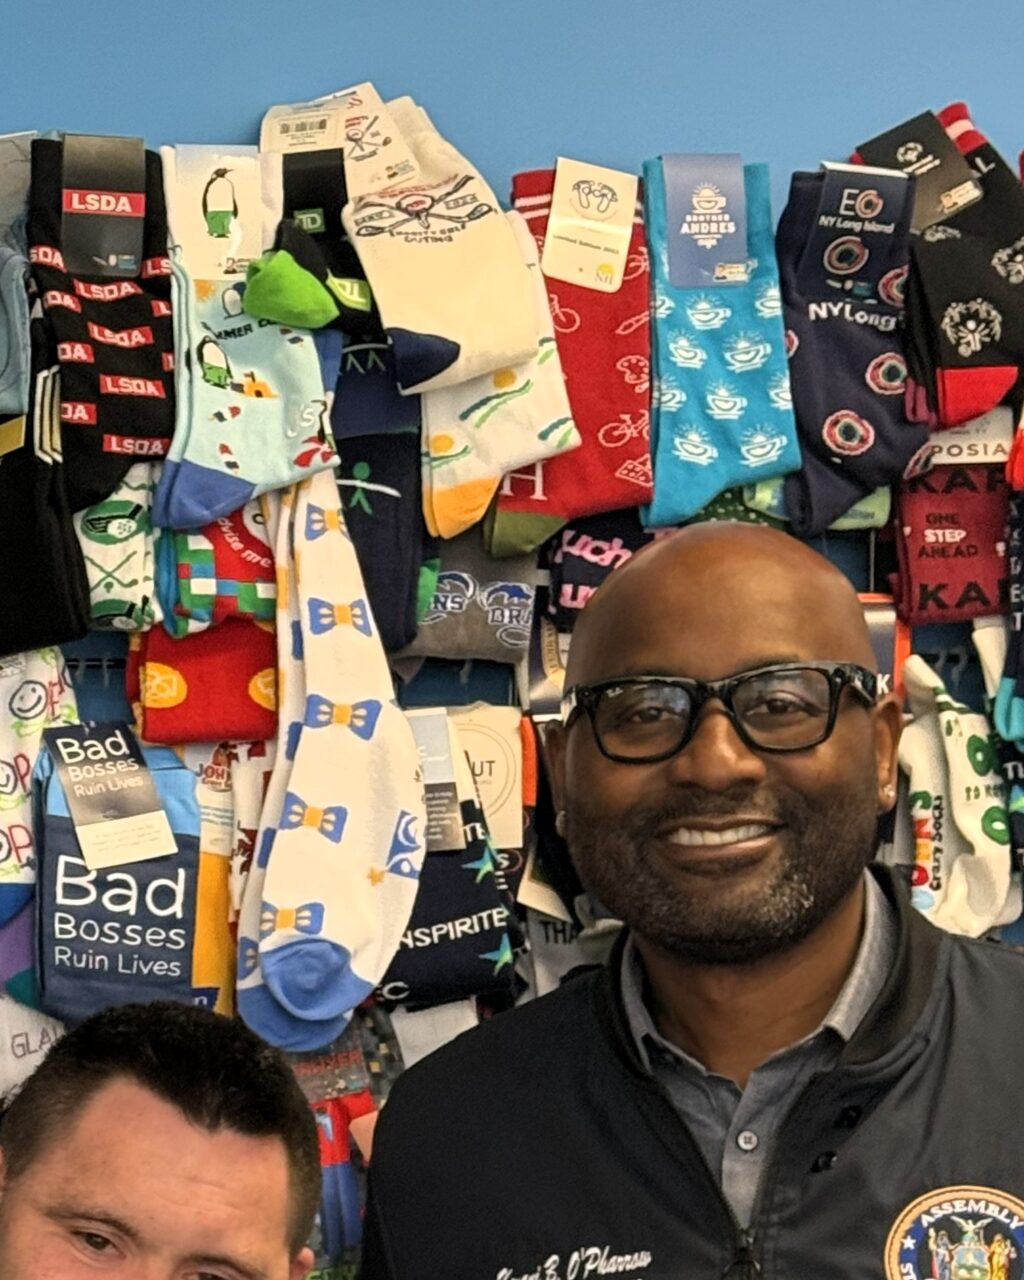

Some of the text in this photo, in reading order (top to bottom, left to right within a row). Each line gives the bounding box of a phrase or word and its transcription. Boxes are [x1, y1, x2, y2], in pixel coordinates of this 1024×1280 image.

[71, 193, 133, 213] LSDA
[297, 212, 322, 231] TD
[836, 217, 862, 233] Long
[863, 220, 895, 233] Island
[79, 280, 137, 300] LSDA
[92, 327, 145, 344] LSDA
[106, 376, 159, 396] LSDA
[111, 436, 164, 454] LSDA
[924, 528, 967, 543] STEP
[918, 545, 979, 559] AHEAD
[56, 729, 130, 764] Bad
[67, 758, 140, 783] Bosses
[74, 775, 144, 798] Ruin Lives
[55, 854, 187, 920] Bad
[53, 911, 187, 951] Bosses
[53, 945, 182, 977] Ruin Lives
[920, 1198, 1024, 1230] ASSEMBLY
